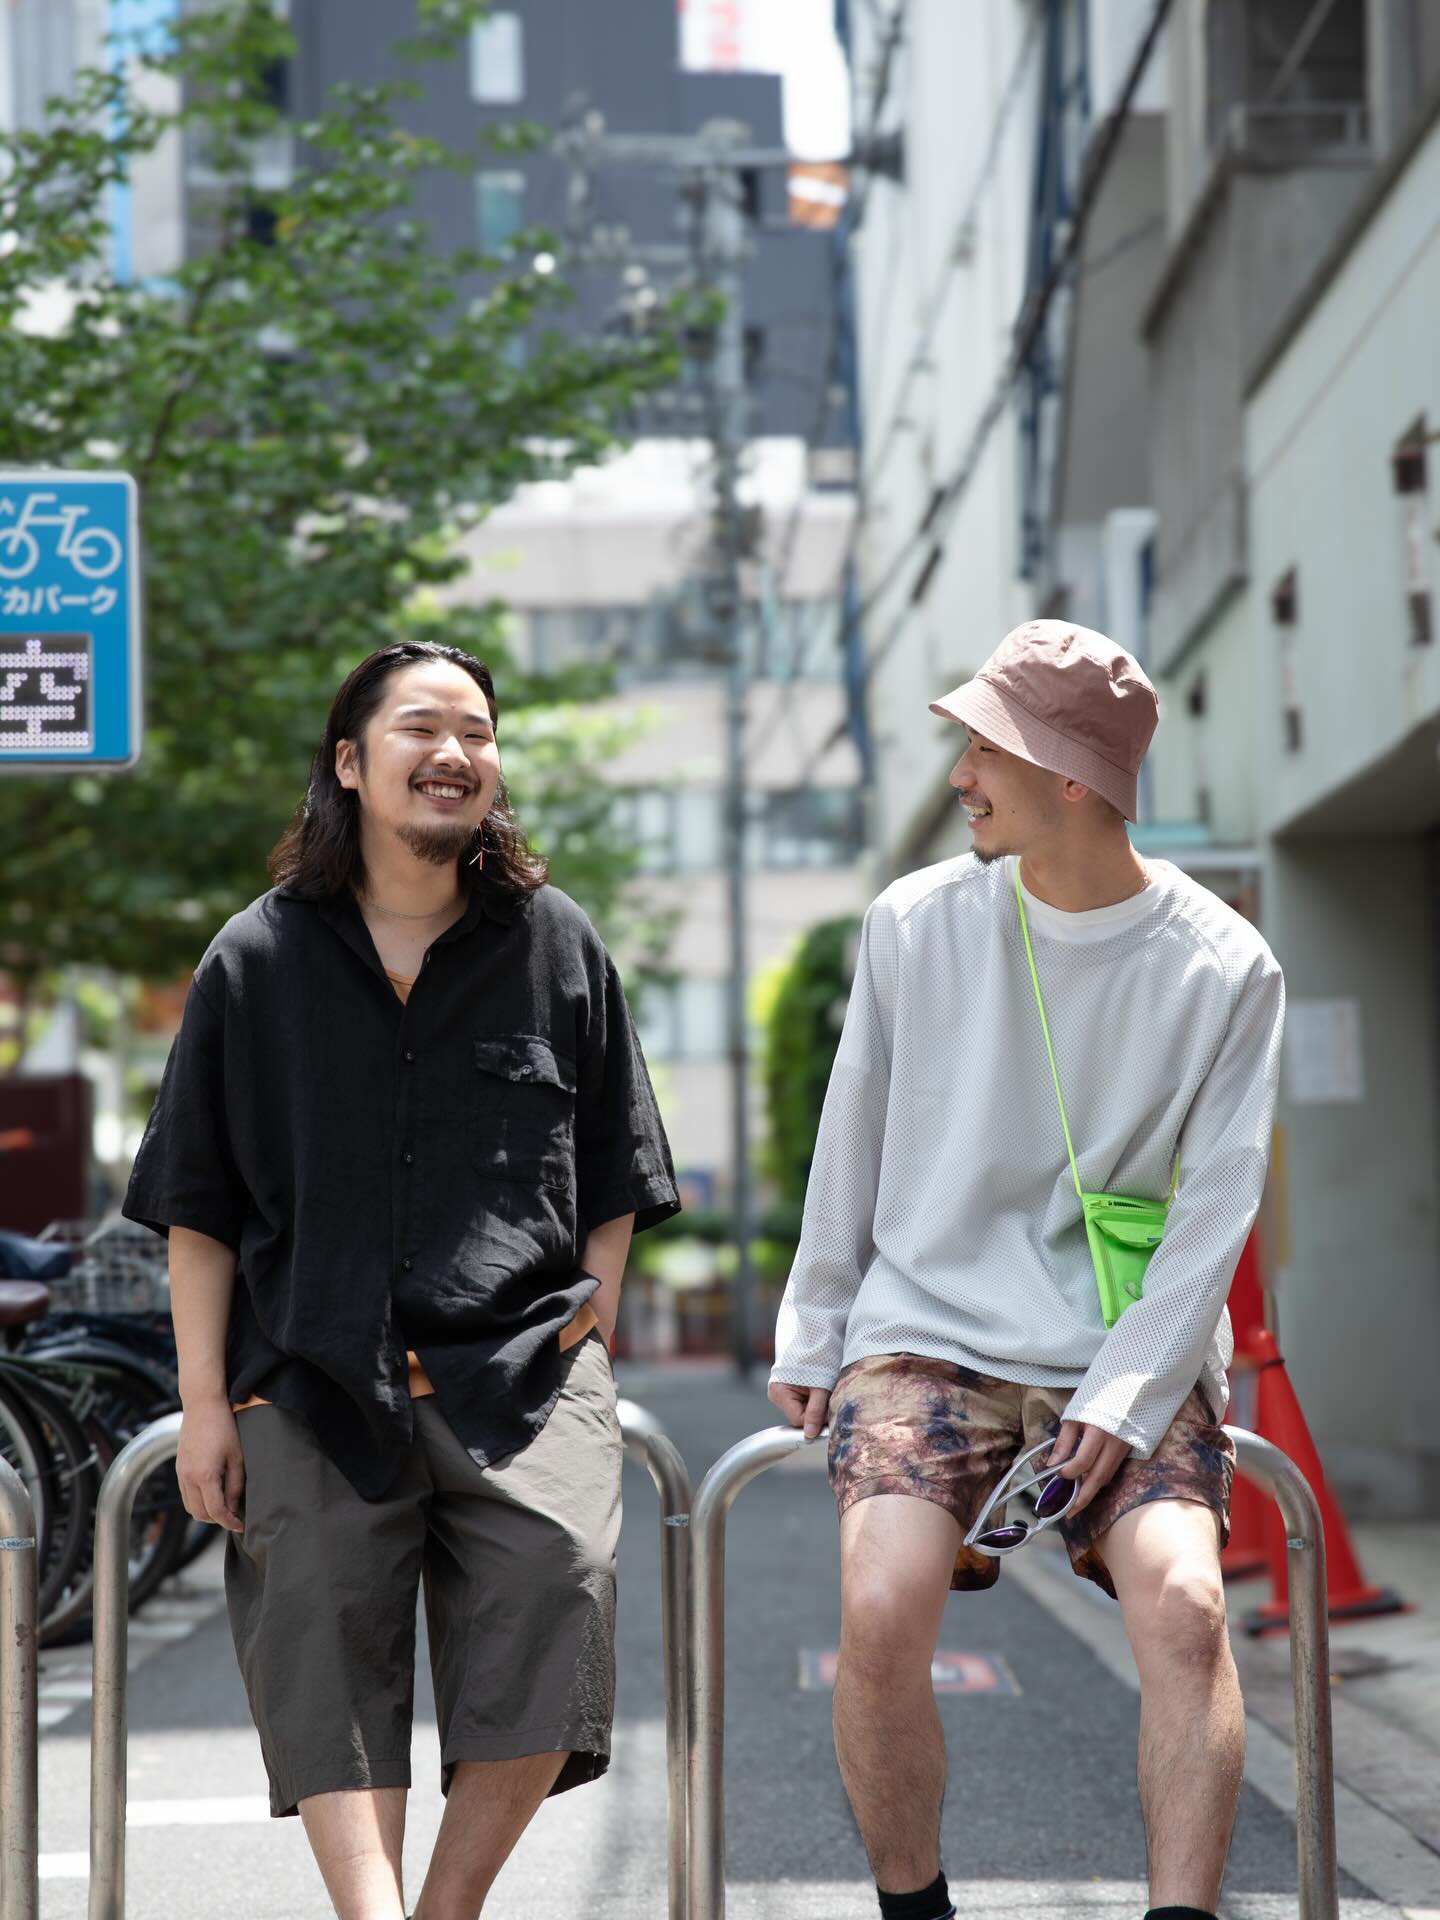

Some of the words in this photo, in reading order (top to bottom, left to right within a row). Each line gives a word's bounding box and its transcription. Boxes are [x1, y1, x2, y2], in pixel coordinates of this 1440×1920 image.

[0, 585, 117, 615] カパーク
[0, 639, 89, 747] 空
